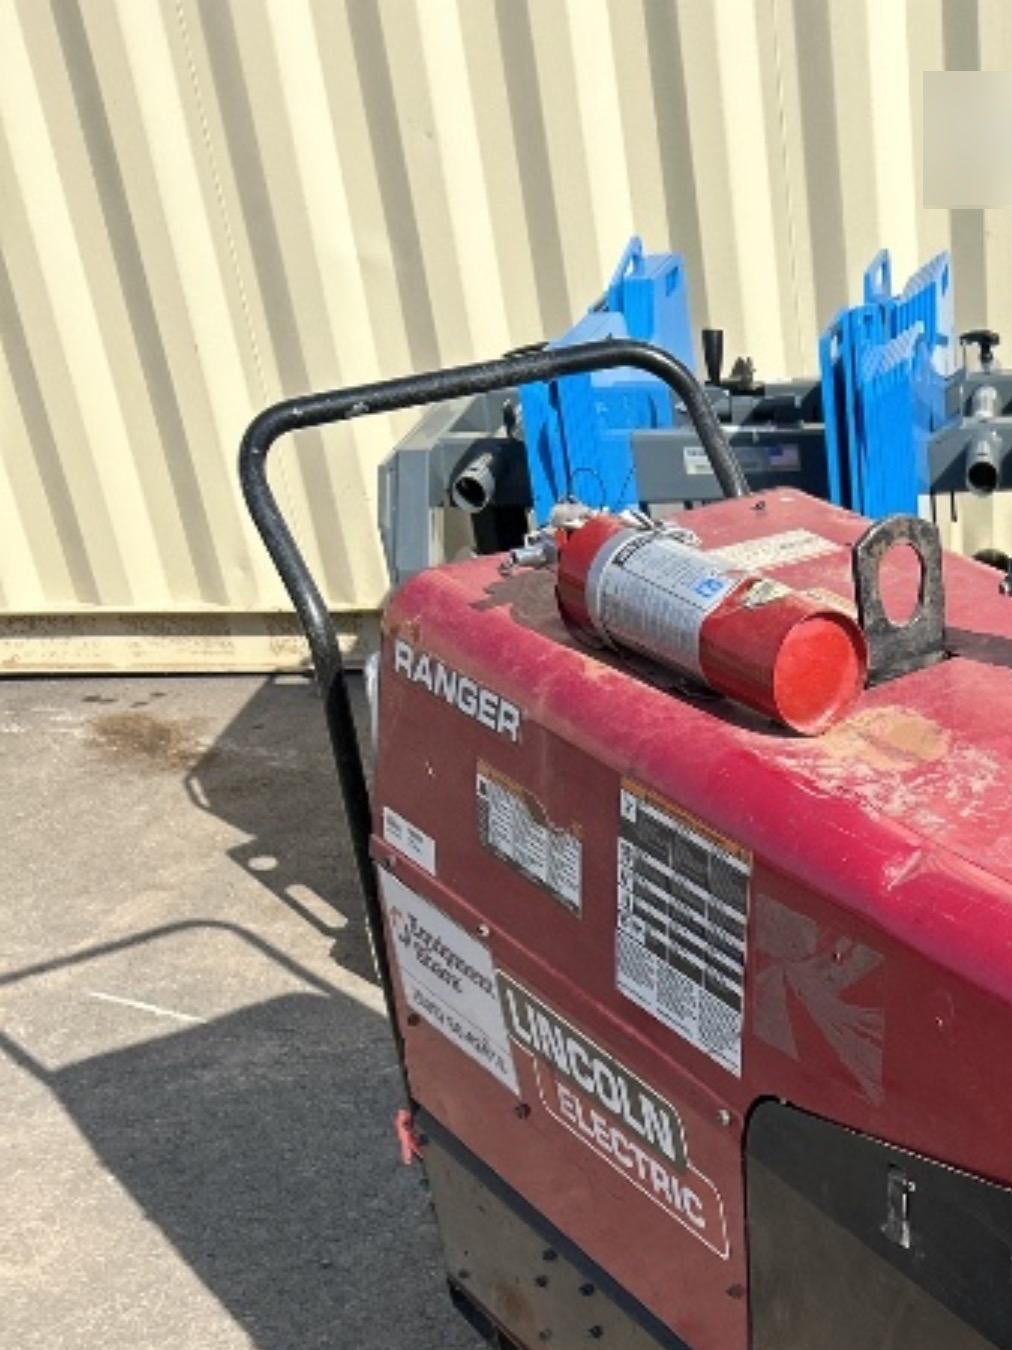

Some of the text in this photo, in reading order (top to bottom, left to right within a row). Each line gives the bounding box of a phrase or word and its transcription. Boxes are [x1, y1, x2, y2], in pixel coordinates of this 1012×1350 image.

[394, 639, 522, 742] RANGER
[505, 988, 677, 1161] LINCOLN
[556, 1079, 705, 1228] ELECTRIC
